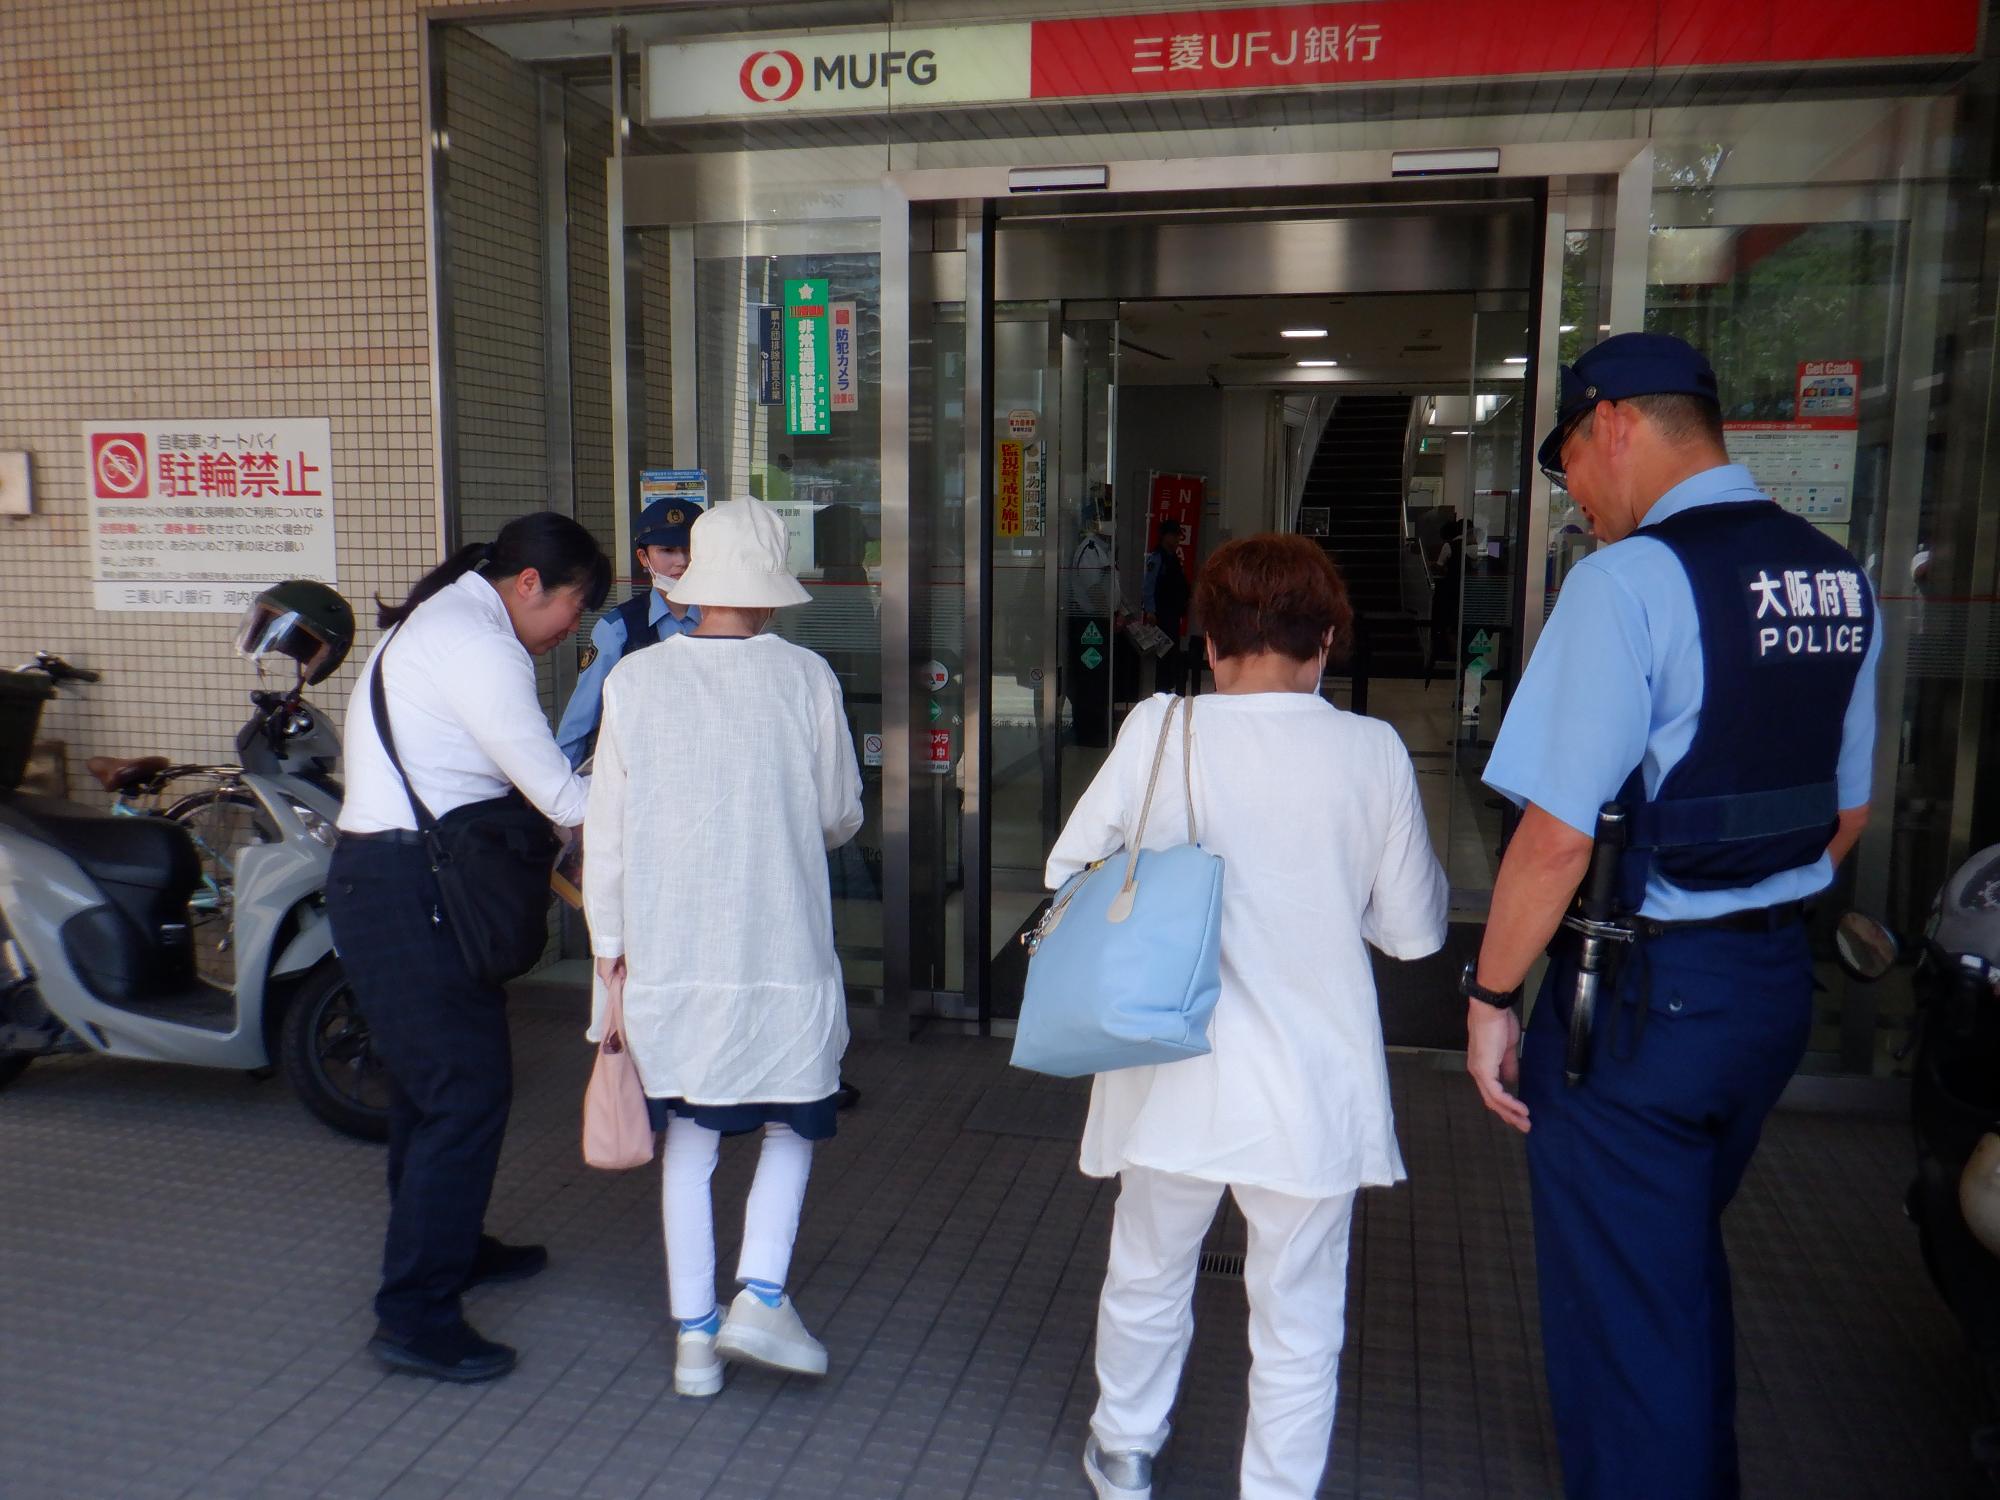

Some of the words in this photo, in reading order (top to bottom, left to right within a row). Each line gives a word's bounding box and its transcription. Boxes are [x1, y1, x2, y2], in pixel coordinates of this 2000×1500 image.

[1131, 24, 1382, 74] 三菱UFJ銀行
[813, 50, 937, 92] MUFG
[836, 329, 849, 391] 防犯カメラ
[1805, 362, 1825, 375] Get
[1826, 362, 1853, 375] Cash
[157, 432, 277, 450] 自転車・オートバイ
[158, 451, 322, 498] 駐輪禁止
[124, 589, 212, 606] 三菱UFJ銀行
[1750, 569, 1863, 619] 大阪府警
[1760, 624, 1863, 656] POLICE
